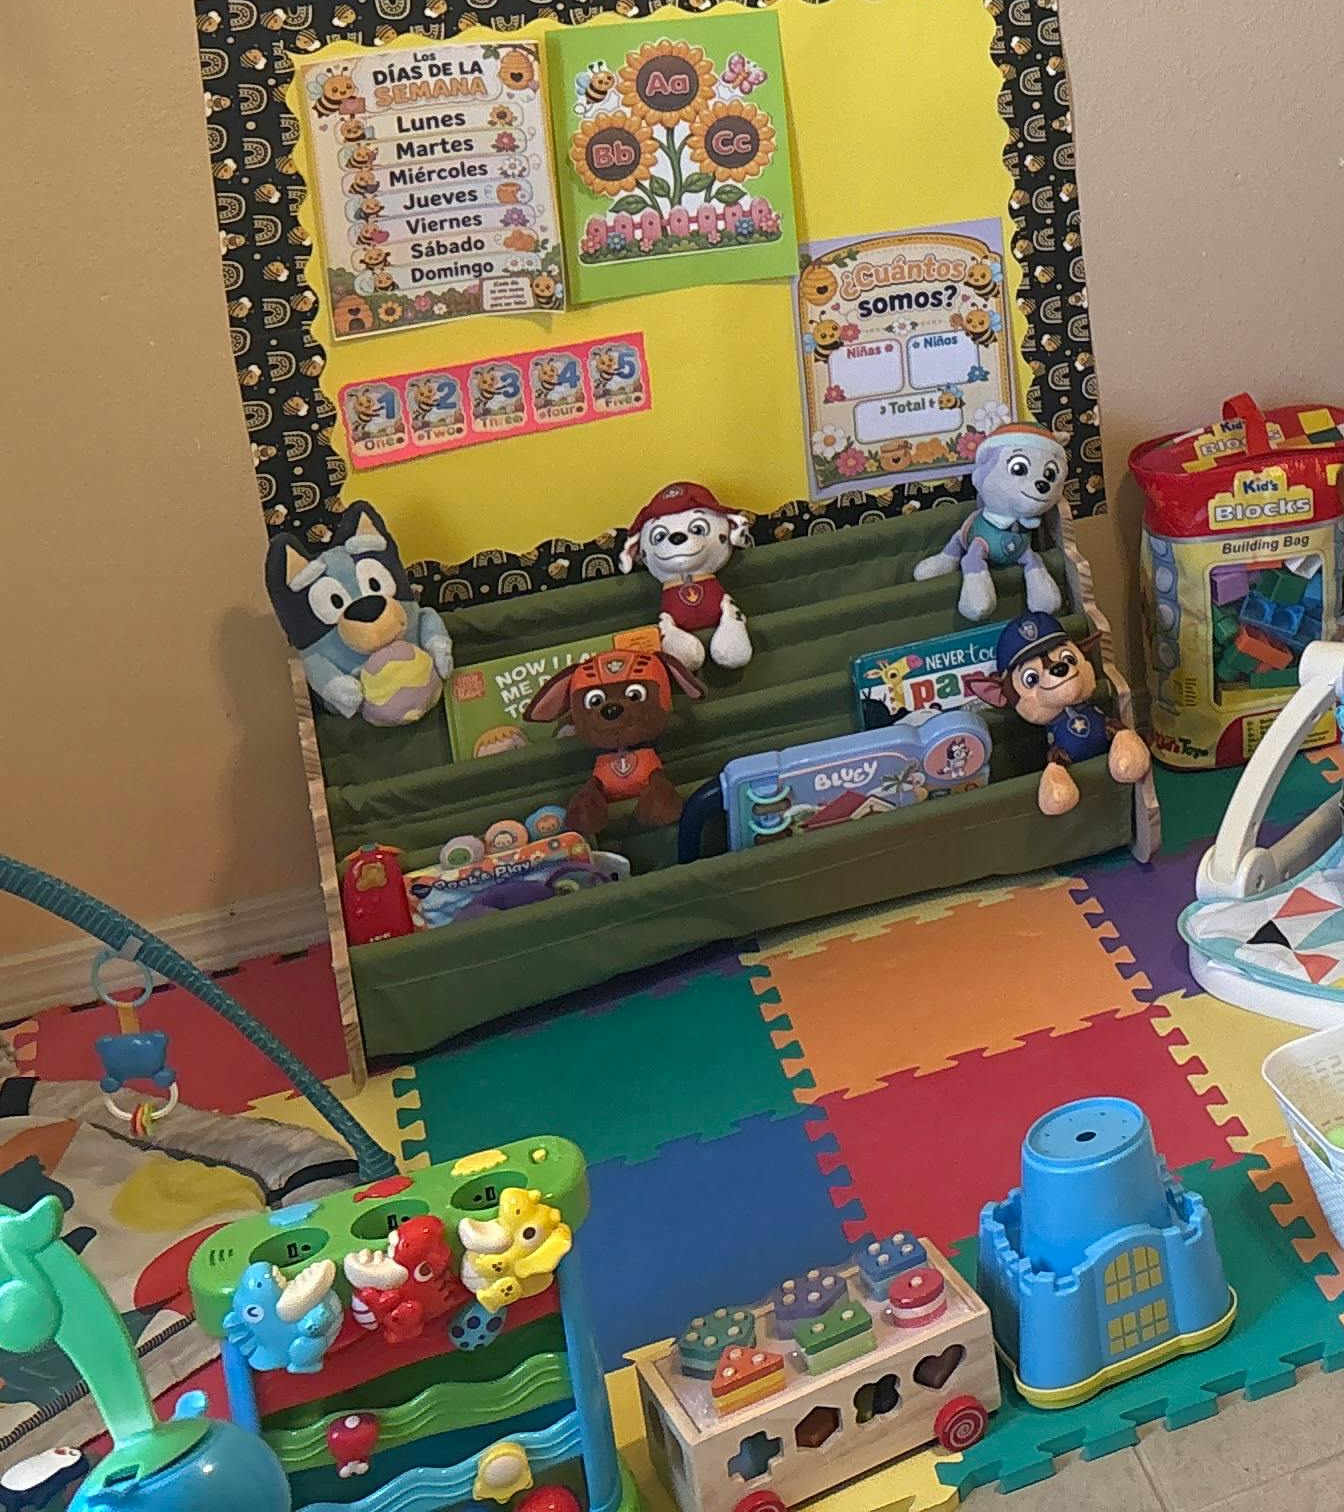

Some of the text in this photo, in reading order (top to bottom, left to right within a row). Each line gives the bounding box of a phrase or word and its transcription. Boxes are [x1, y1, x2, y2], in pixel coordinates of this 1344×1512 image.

[413, 52, 436, 63] Los
[372, 60, 483, 86] DÍAS DE LA
[646, 72, 690, 96] Aa
[374, 76, 488, 107] SEMANA
[396, 112, 466, 134] Lunes
[396, 137, 474, 160] Martes
[592, 140, 635, 169] Bb
[712, 130, 752, 156] Cc
[389, 162, 488, 187] Miércoles
[404, 188, 478, 210] Jueves
[406, 213, 482, 235] Viernes
[411, 236, 485, 259] Sábado
[412, 259, 494, 284] Domingo
[840, 254, 966, 301] ¿Cuántos
[858, 284, 958, 318] somos?
[846, 344, 882, 359] Niñas
[924, 335, 958, 349] Niños
[558, 361, 580, 389] 4
[616, 350, 636, 378] 5
[436, 381, 458, 409] 2
[500, 372, 520, 398] 3
[376, 392, 396, 420] 1
[889, 398, 926, 415] Total
[364, 435, 394, 451] One
[422, 427, 456, 441] Two
[1242, 480, 1279, 494] Kid's
[1214, 498, 1311, 522] Blocks
[1222, 535, 1310, 555] Building Bag
[925, 649, 965, 671] NEVER
[494, 658, 546, 689] NOW
[500, 682, 534, 704] ME
[814, 760, 878, 790] BLUEY
